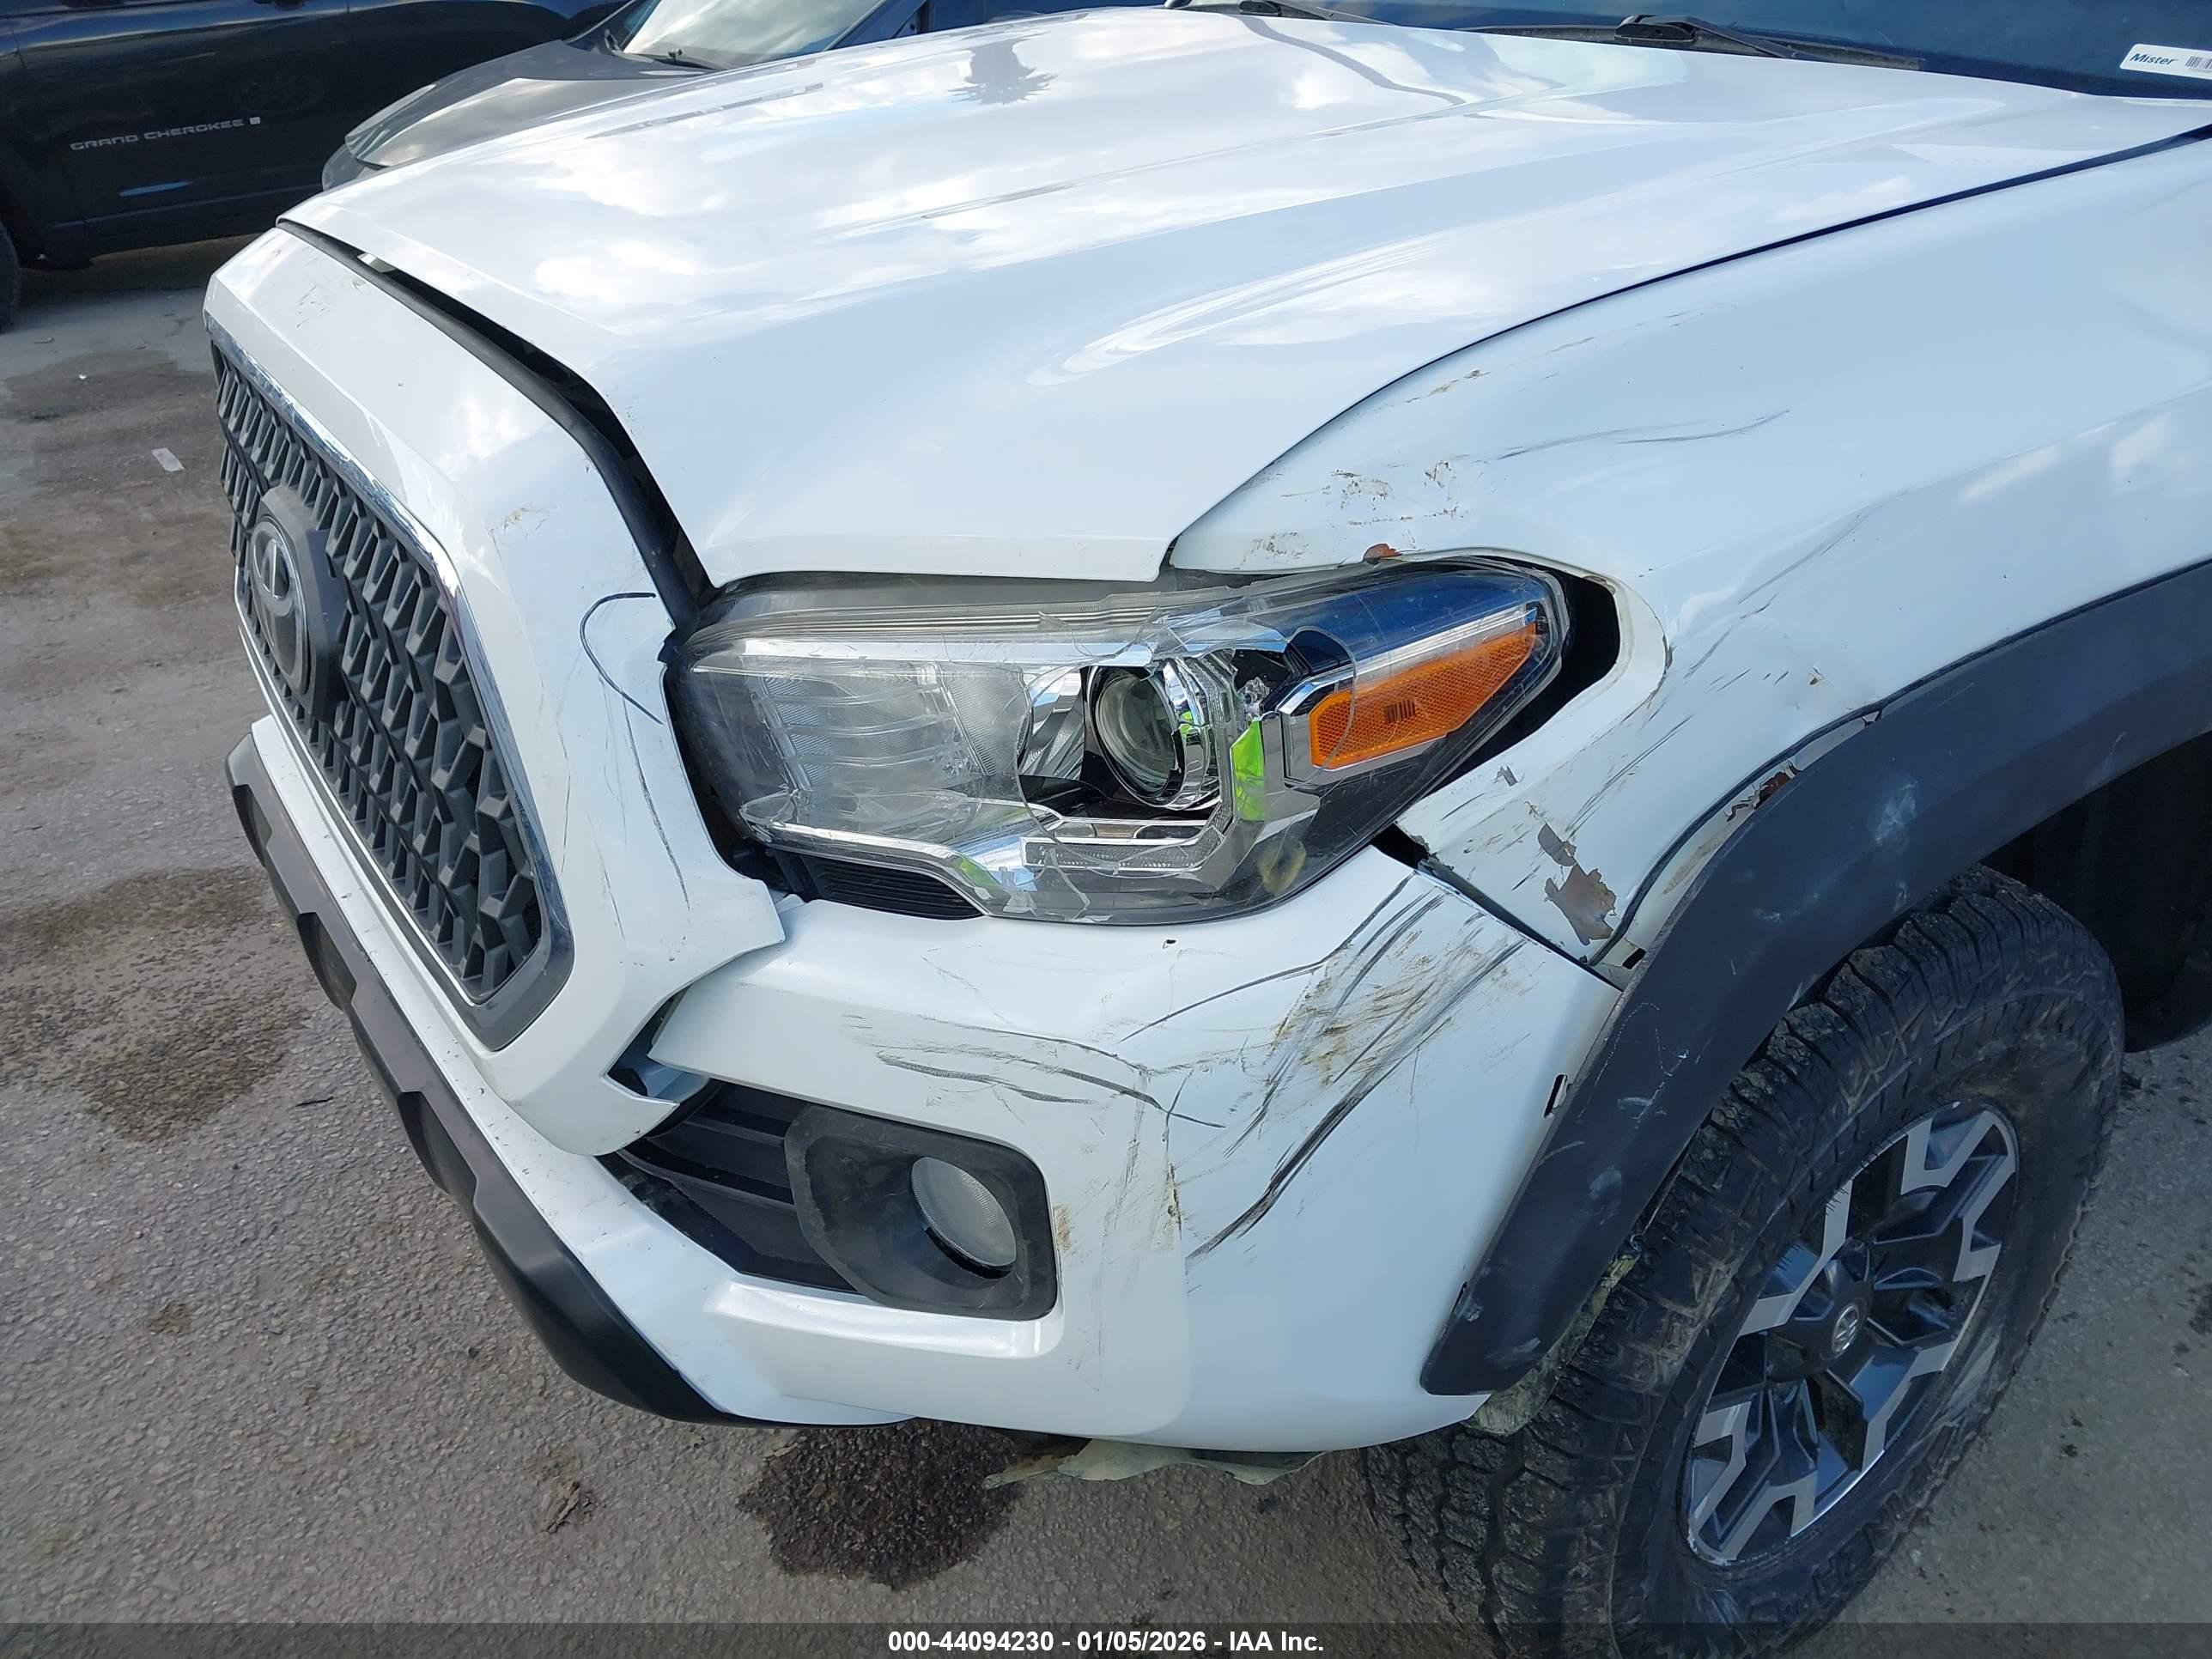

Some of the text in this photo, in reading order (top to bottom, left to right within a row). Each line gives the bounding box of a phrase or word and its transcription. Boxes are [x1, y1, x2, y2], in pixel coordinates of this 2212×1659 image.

[2130, 53, 2178, 65] Mister
[70, 134, 139, 150] GRAND
[143, 118, 244, 140] CHEROKEE
